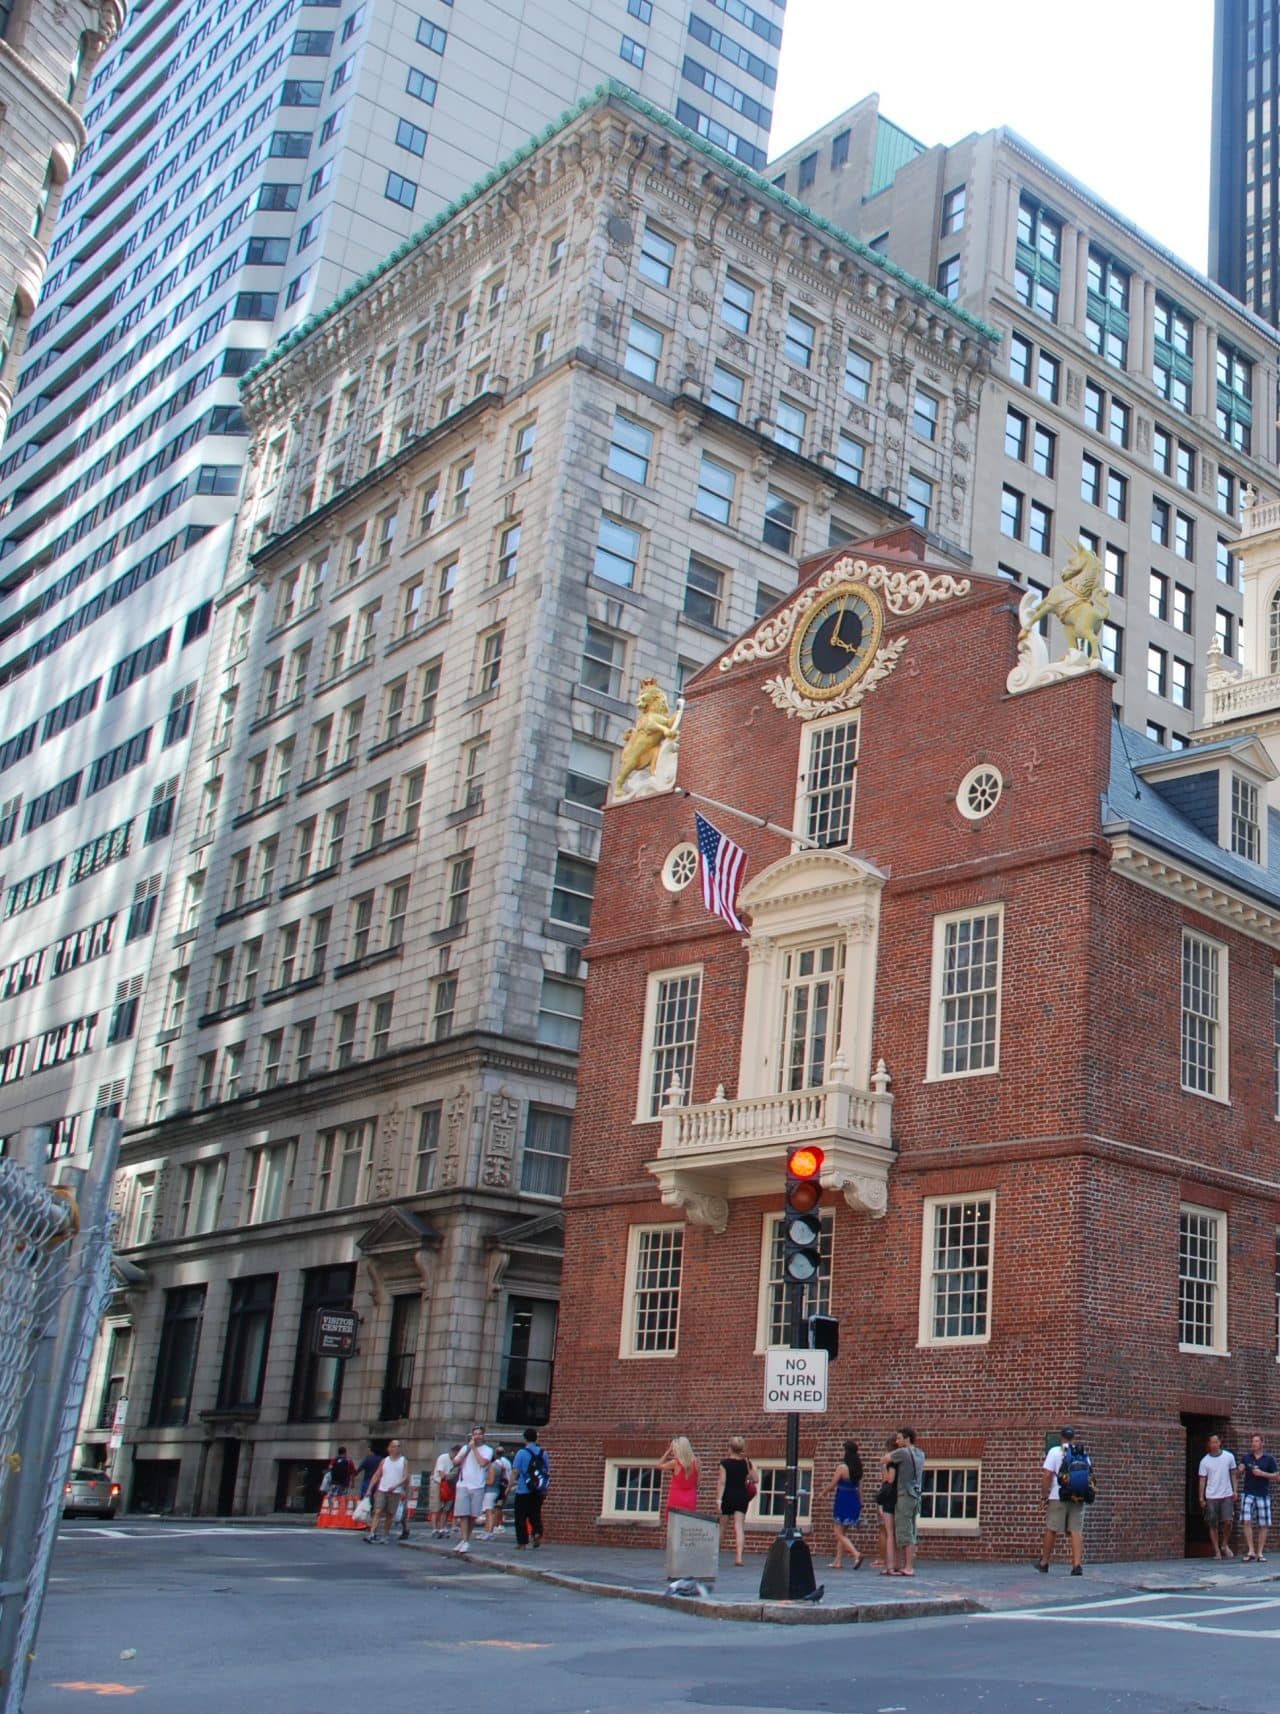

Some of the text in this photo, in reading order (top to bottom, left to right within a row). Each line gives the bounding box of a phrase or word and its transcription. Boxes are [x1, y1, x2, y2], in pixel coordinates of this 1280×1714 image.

[323, 1316, 354, 1326] VISITOR
[321, 1323, 353, 1333] CENTER
[785, 1358, 807, 1371] NO
[776, 1374, 816, 1386] TURN
[768, 1390, 823, 1402] ON RED
